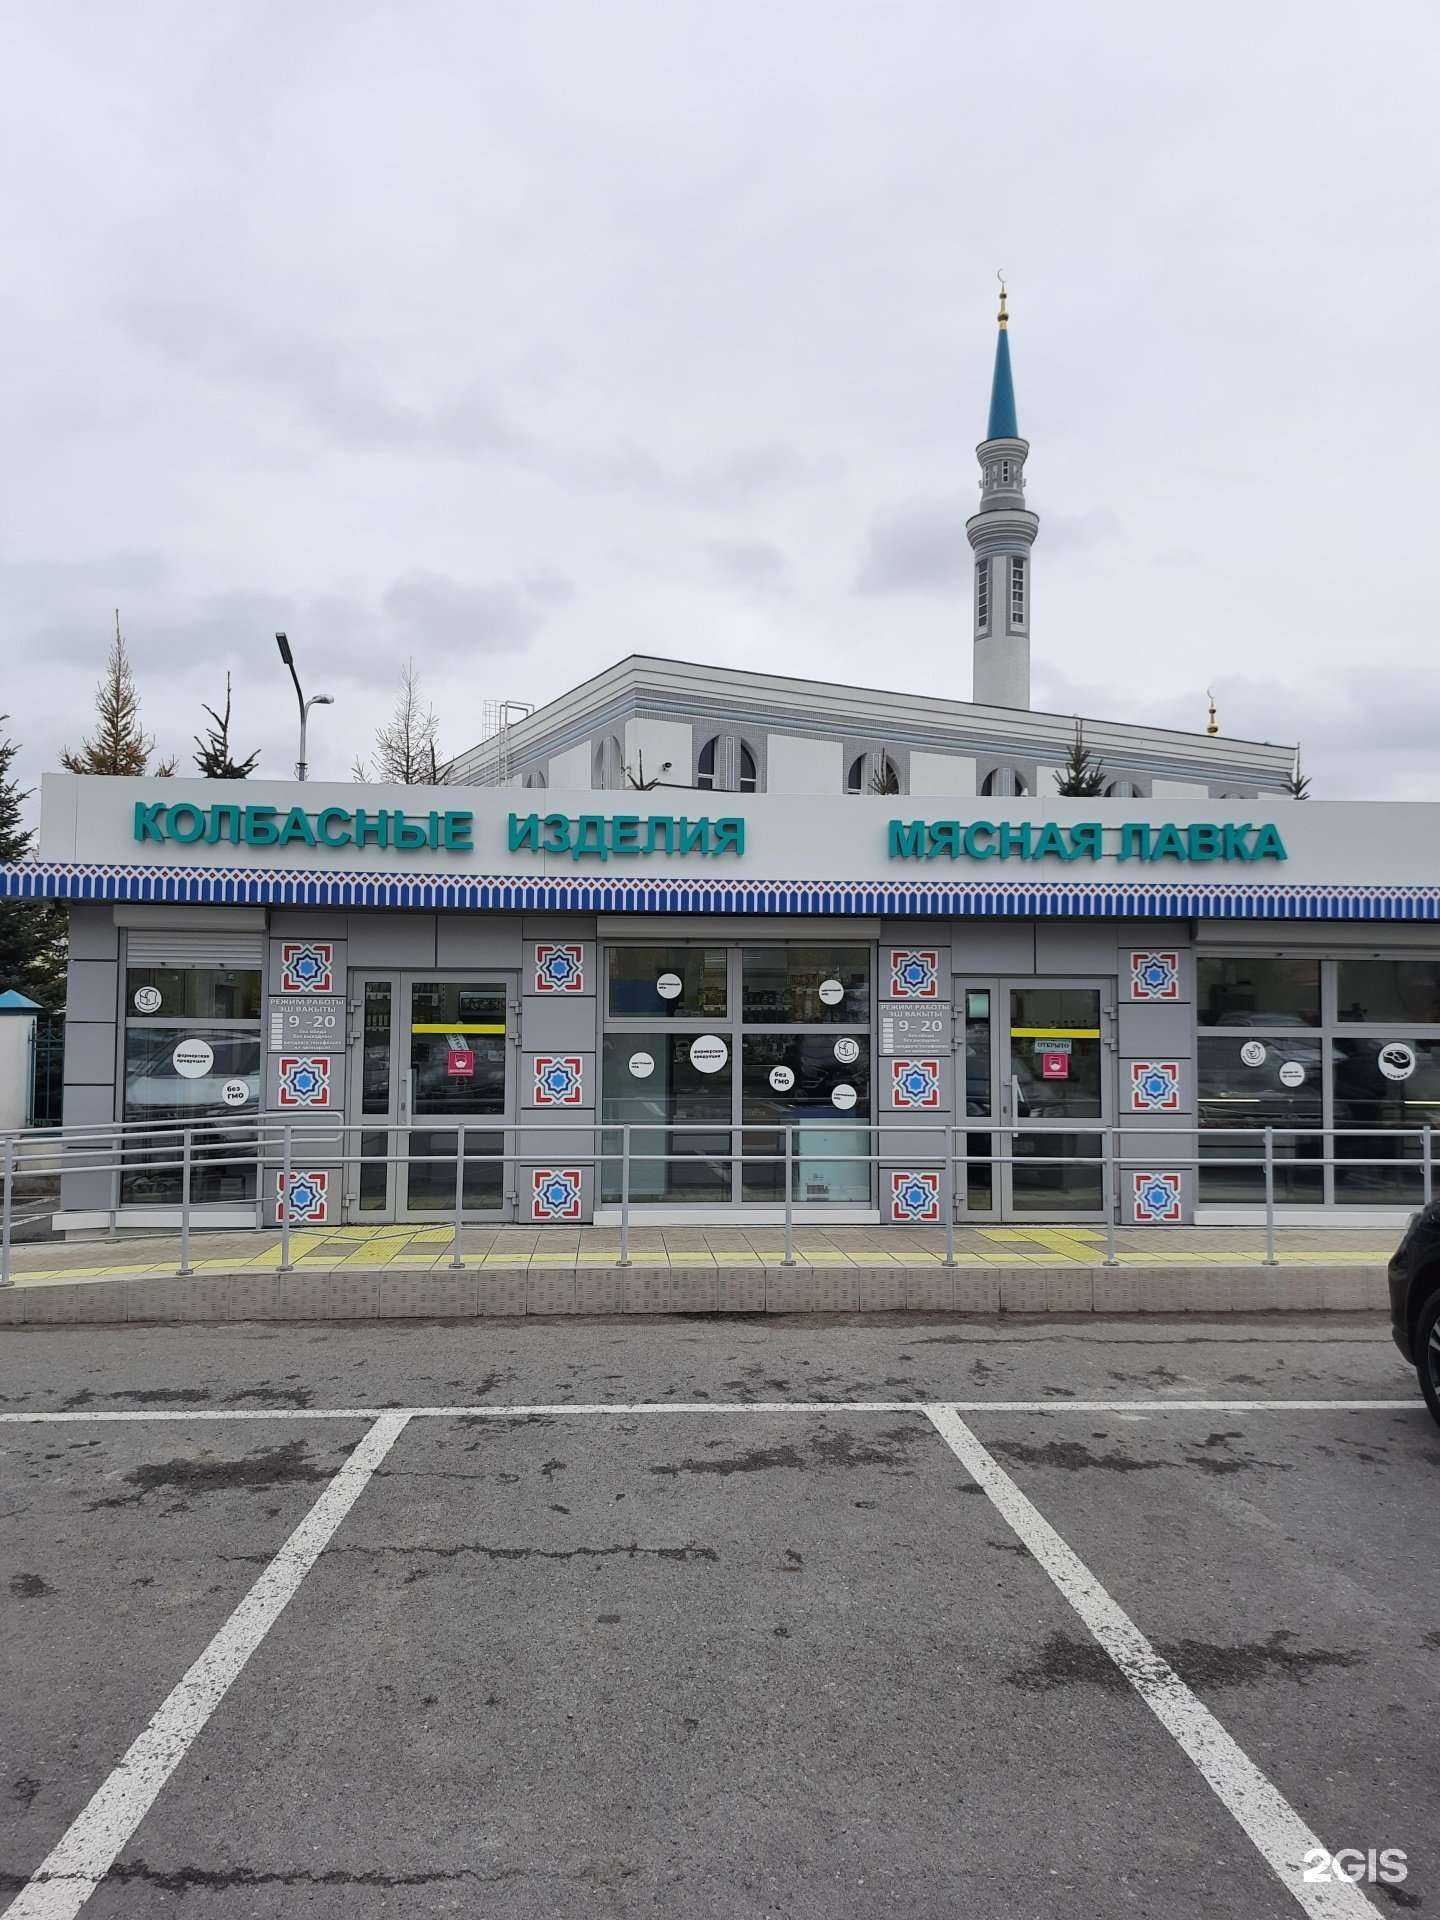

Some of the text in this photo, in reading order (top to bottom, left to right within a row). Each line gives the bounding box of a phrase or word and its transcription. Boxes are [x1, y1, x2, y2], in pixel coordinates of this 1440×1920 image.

[134, 801, 745, 862] КОЛБАСНЫЕ ИЗДЕЛИЯ
[887, 819, 1288, 862] МЯСНАЯ ЛАВКА
